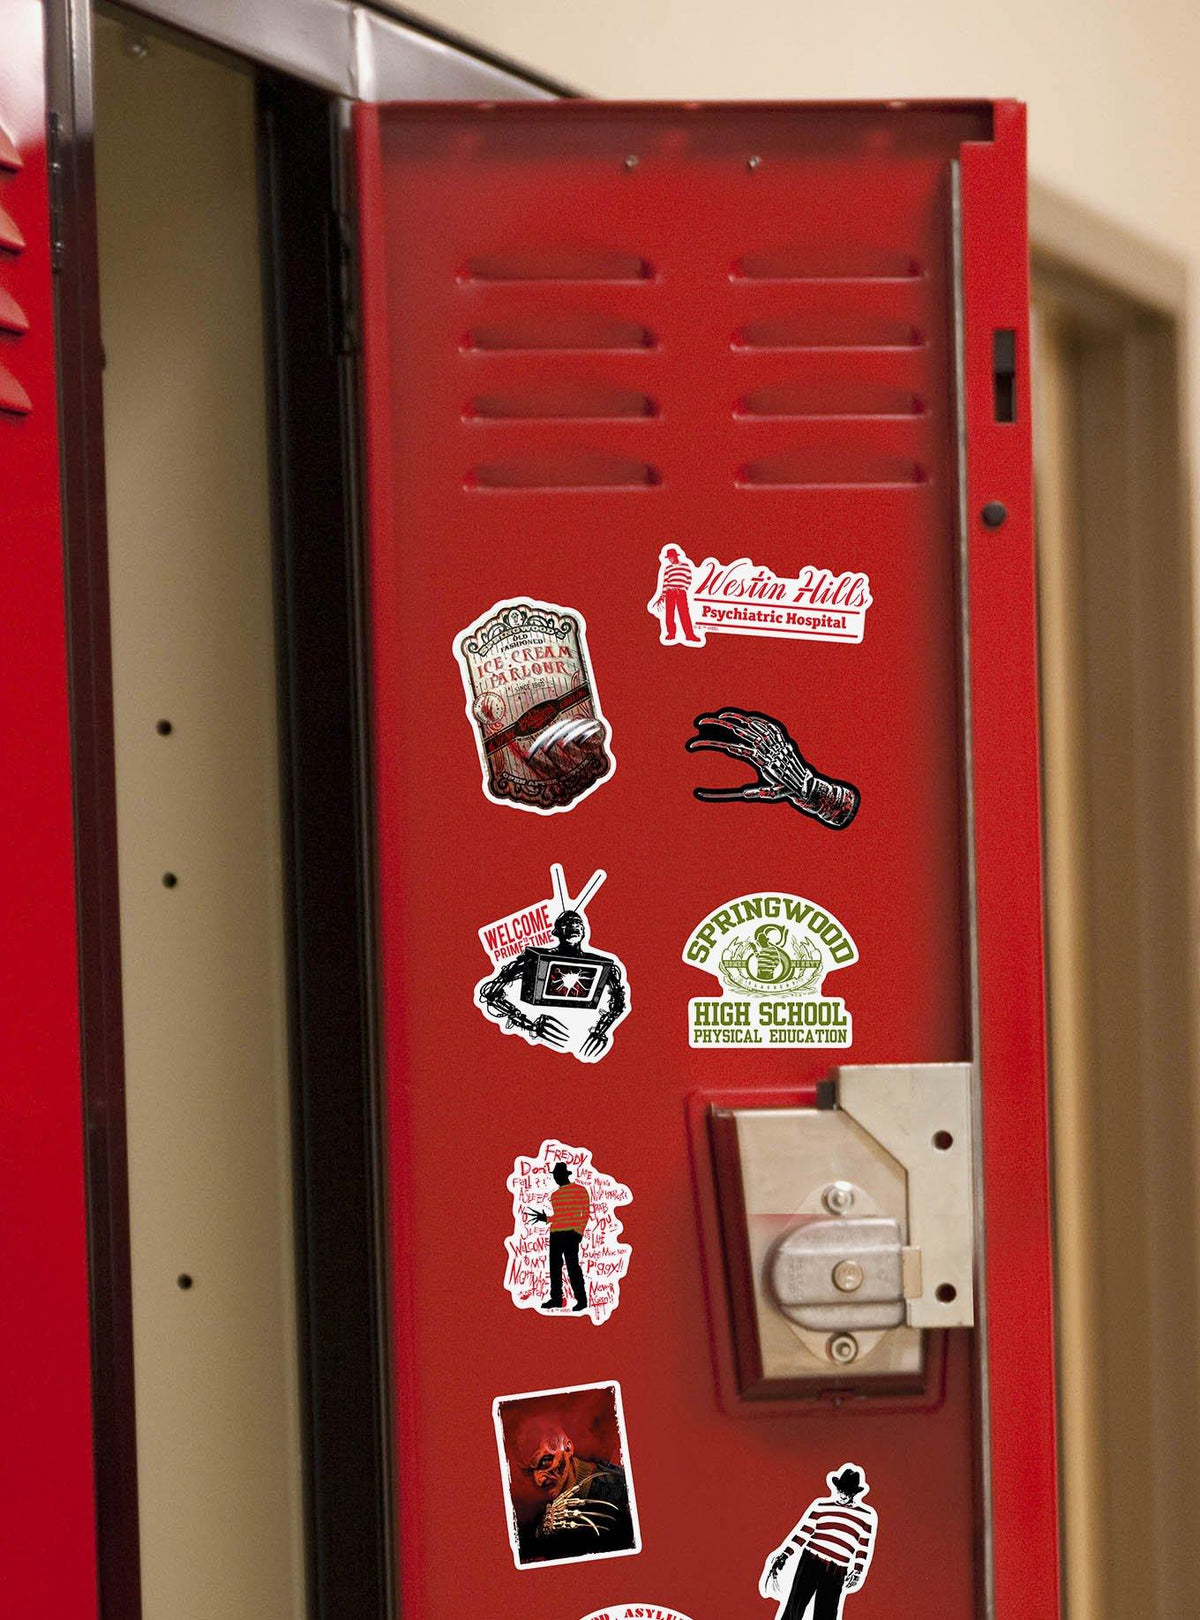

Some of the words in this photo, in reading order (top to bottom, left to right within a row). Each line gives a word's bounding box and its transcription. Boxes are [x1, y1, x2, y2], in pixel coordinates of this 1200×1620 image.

[695, 562, 786, 600] Westin
[793, 570, 868, 607] Hills
[702, 605, 783, 624] Psychiatric
[786, 613, 847, 629] Hospital
[501, 638, 543, 652] FASHIONED
[512, 633, 528, 642] OLD
[477, 656, 503, 678] ICE
[511, 645, 573, 663] CREAM
[490, 660, 569, 688] PARLOUR
[484, 905, 552, 951] WELCOME
[687, 897, 855, 963] SPRINGWOOD
[494, 941, 525, 961] PRIME
[529, 930, 554, 947] TIME
[694, 1002, 751, 1026] HIGH
[759, 1002, 847, 1026] SCHOOL
[694, 1029, 762, 1043] PHYSICAL
[769, 1029, 847, 1043] EDUCATION
[544, 1144, 588, 1168] FREDDY
